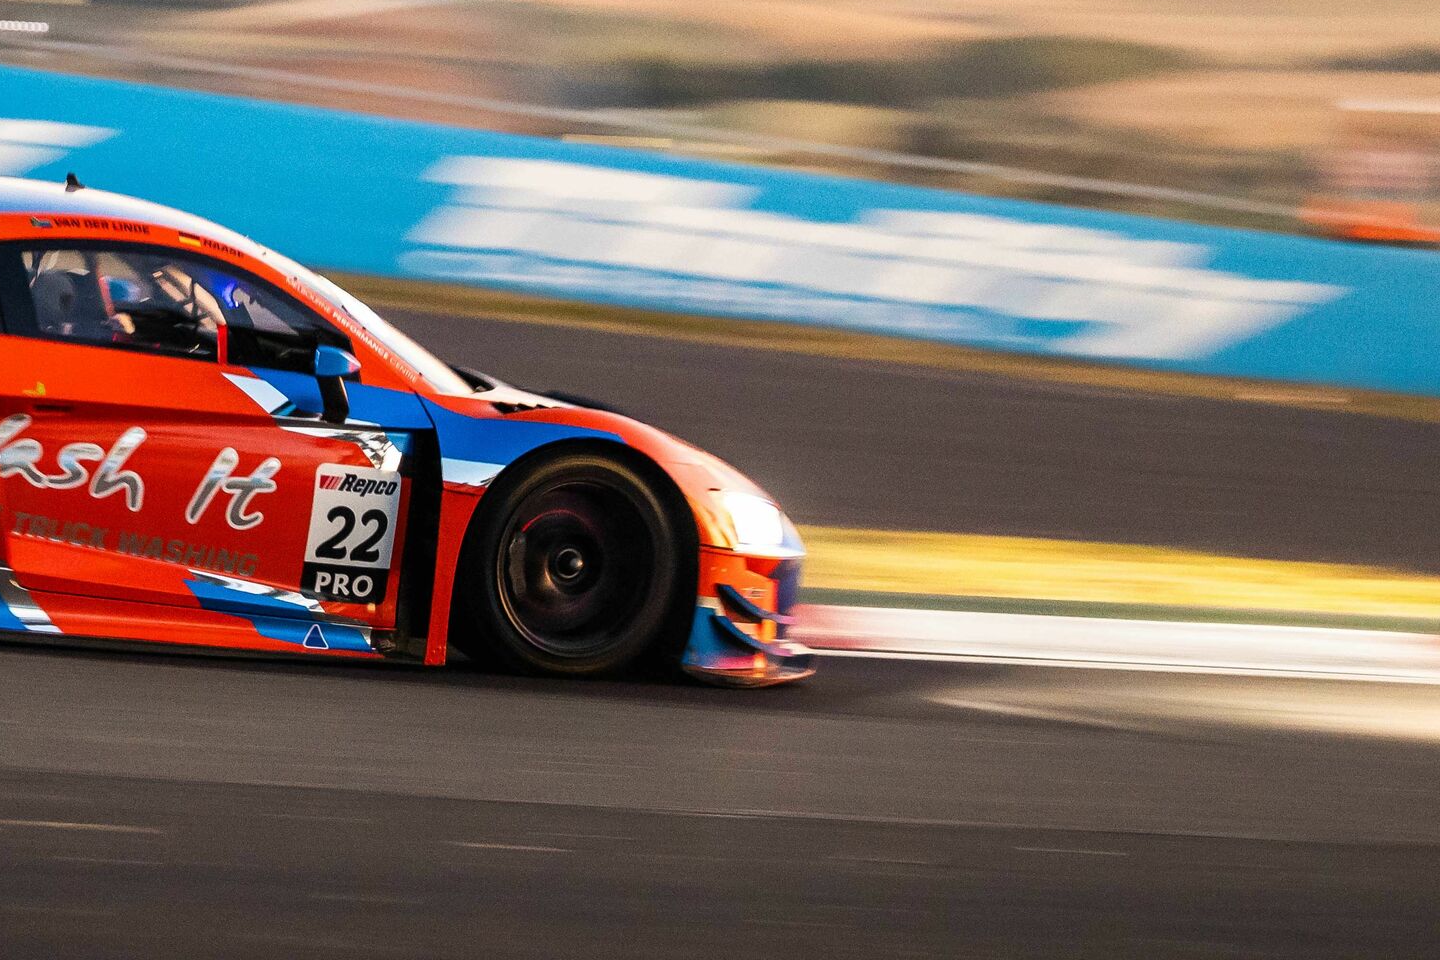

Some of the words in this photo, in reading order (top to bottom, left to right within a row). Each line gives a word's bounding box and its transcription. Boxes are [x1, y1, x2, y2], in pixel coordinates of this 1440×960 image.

[53, 217, 81, 228] VAN
[83, 218, 109, 230] DER
[112, 221, 150, 235] LINDE
[332, 310, 389, 360] PERFORMANCE
[184, 447, 283, 531] It
[338, 472, 398, 498] Repco
[13, 511, 107, 551] TRUCK
[118, 529, 261, 577] WASHING
[315, 505, 389, 563] 22
[314, 571, 374, 598] PRO
